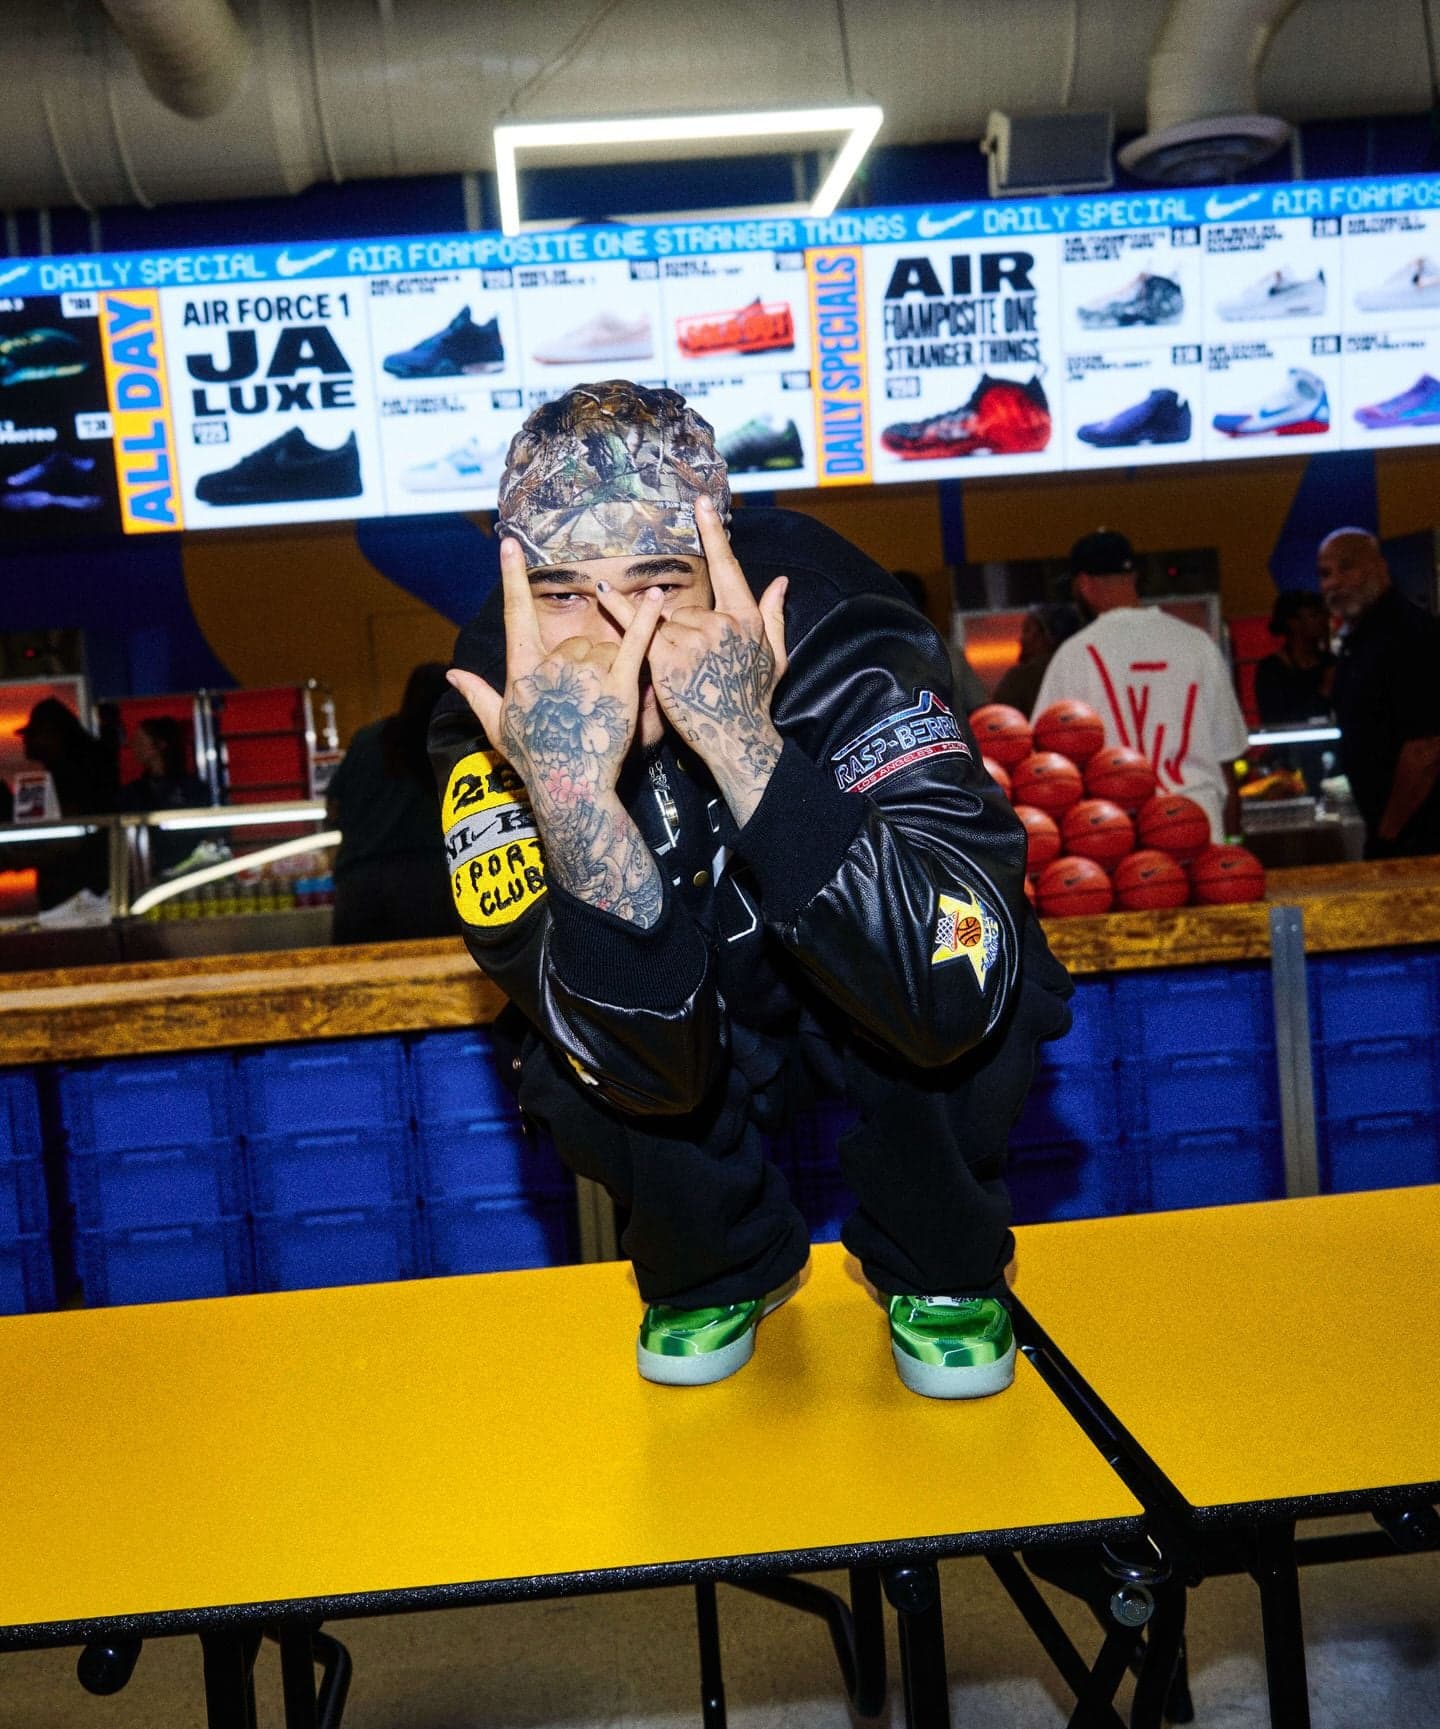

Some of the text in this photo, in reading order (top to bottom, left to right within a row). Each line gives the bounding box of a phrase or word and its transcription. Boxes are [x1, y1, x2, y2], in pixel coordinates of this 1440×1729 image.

[983, 198, 1195, 234] DAILY SPECIAL
[1272, 187, 1325, 215] AIR
[348, 214, 907, 271] AIR FOAMPOSITE ONE STRANGER THINGS
[40, 253, 266, 291] DAILY SPECIAL
[883, 251, 1036, 299] AIR
[184, 293, 350, 327] AIR FORCE 1
[884, 297, 1037, 341] FOAMPOSITE ONE
[186, 325, 353, 383] JA
[815, 256, 865, 475] DAILY SPECIALS
[885, 338, 1040, 371] STRANGER THINGS
[105, 297, 176, 524] ALL DAY
[192, 379, 356, 417] LUXE
[857, 776, 879, 790] LOS
[880, 747, 934, 776] ANGELES
[455, 840, 546, 898] SPORT
[479, 866, 545, 916] CLUB
